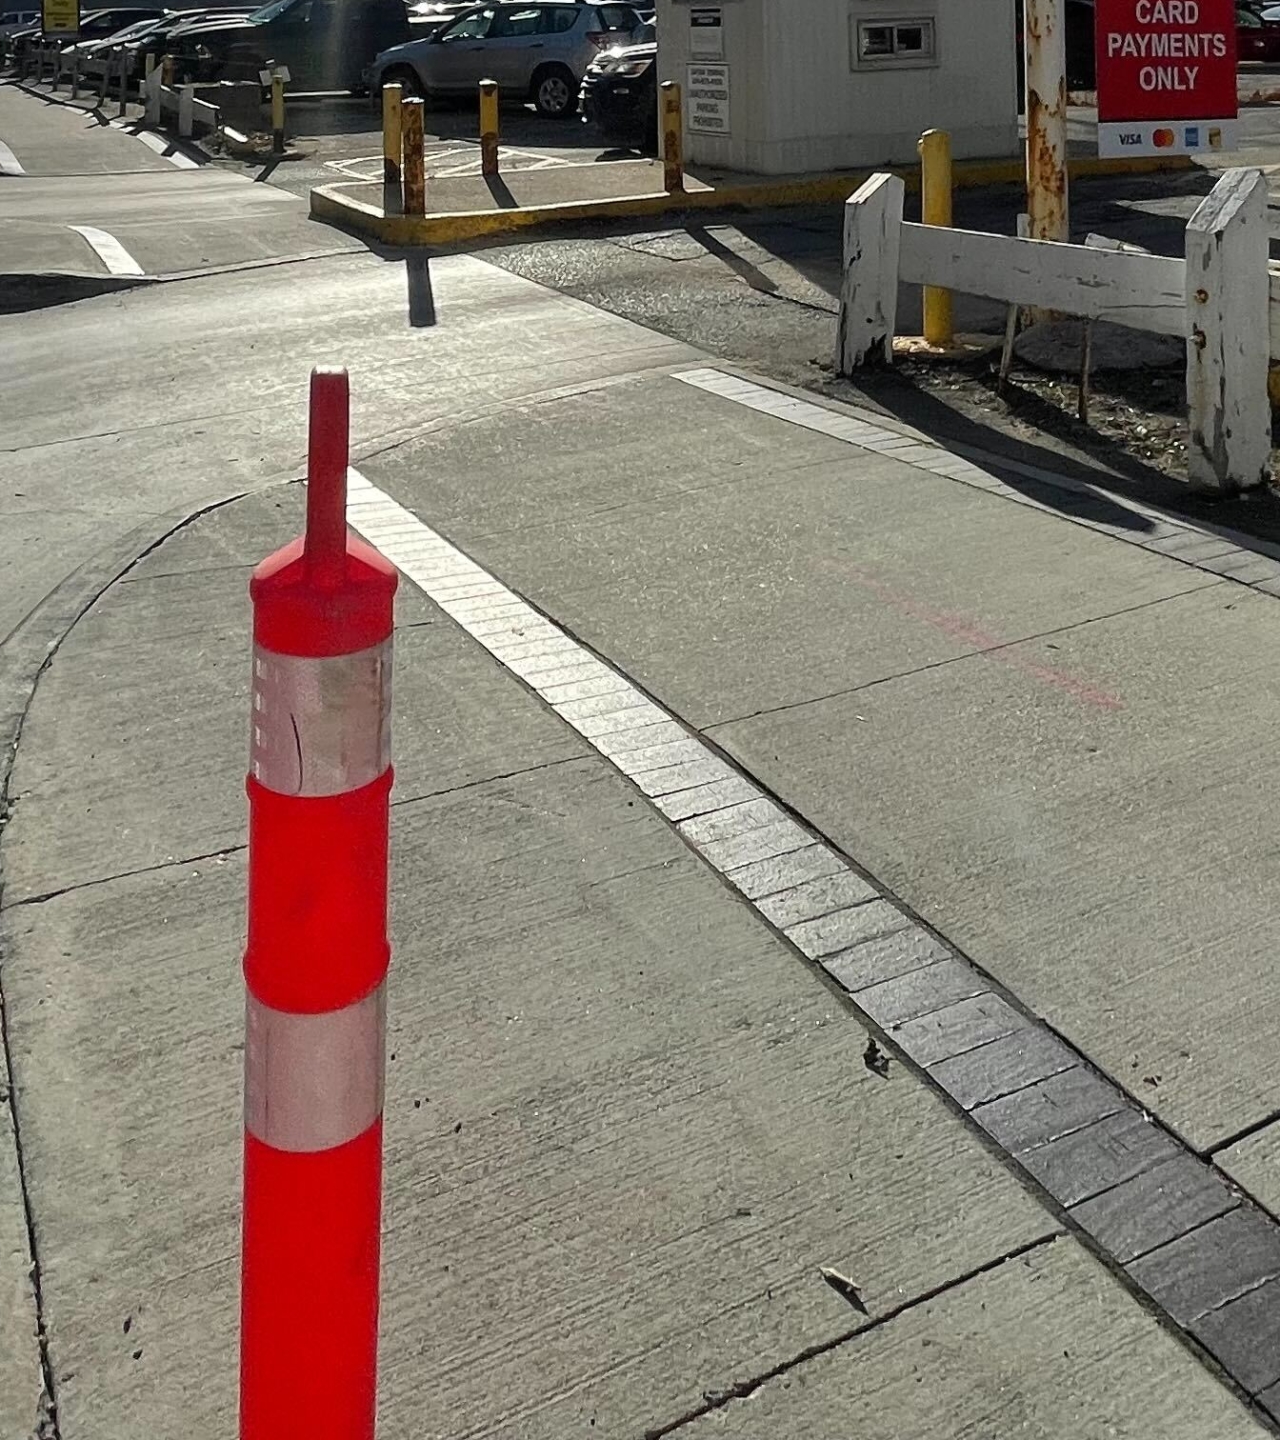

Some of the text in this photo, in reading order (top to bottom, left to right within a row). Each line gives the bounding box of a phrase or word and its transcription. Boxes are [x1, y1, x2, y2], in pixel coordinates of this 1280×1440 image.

[1135, 0, 1199, 24] CARD
[1107, 33, 1227, 58] PAYMENTS
[1139, 66, 1199, 91] ONLY
[1119, 133, 1143, 146] VISA
